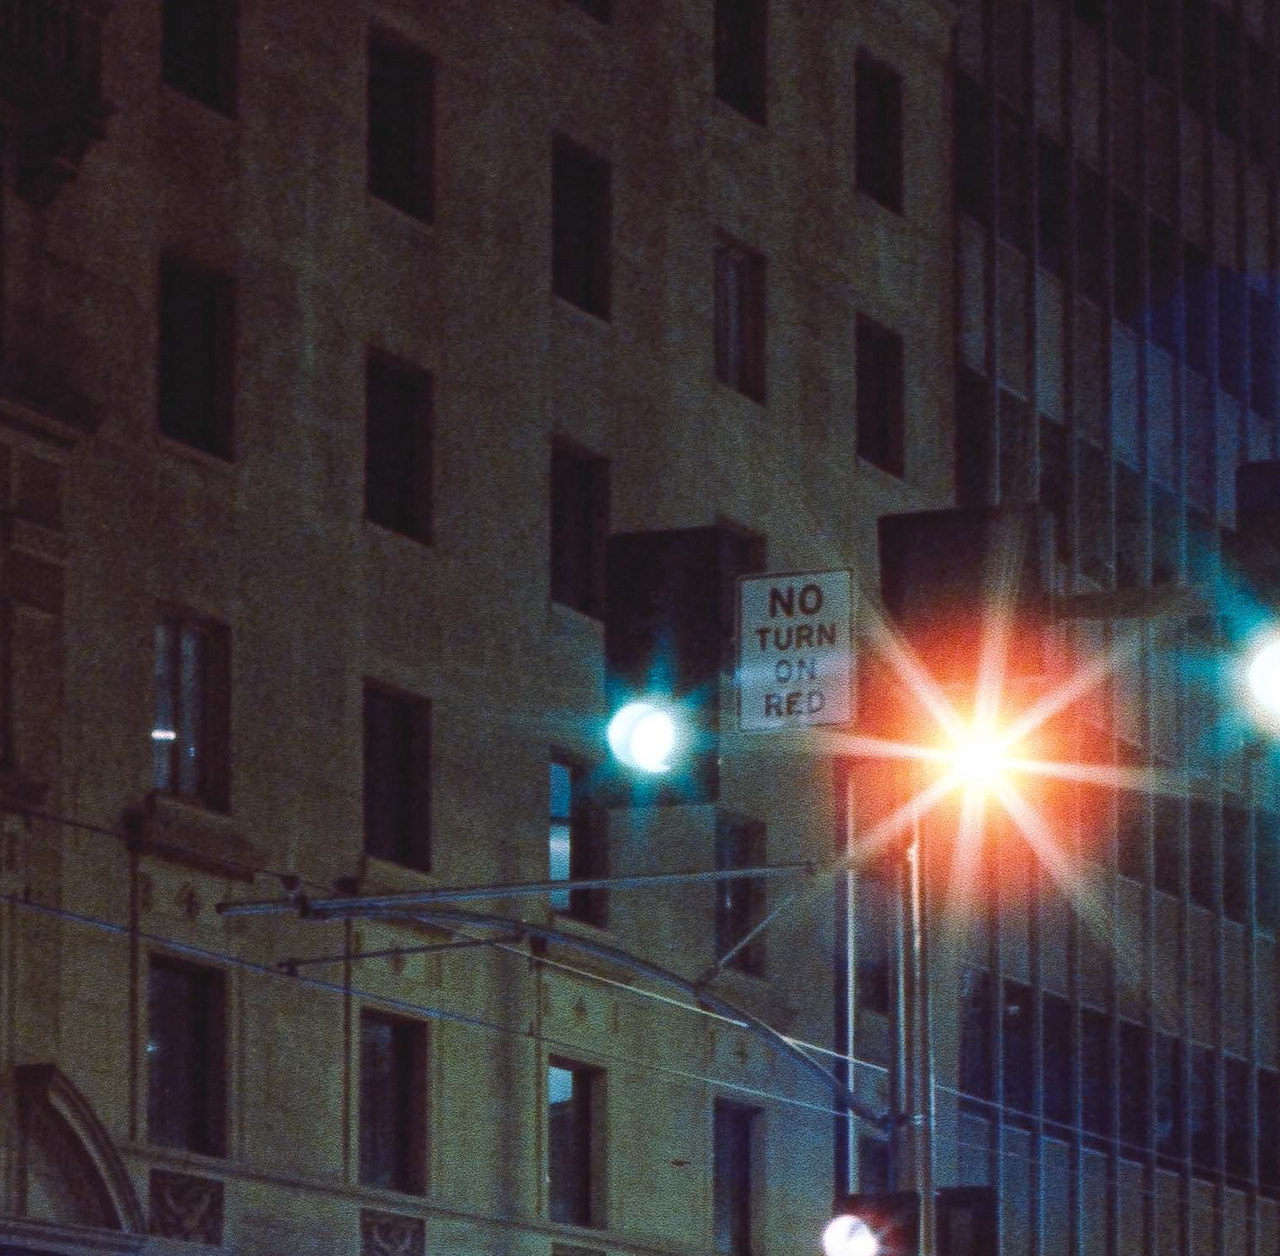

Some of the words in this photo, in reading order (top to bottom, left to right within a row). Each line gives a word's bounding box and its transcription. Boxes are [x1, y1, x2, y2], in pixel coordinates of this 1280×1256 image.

[770, 583, 822, 618] NO
[756, 623, 836, 651] TURN
[775, 658, 817, 683] ON
[764, 690, 825, 718] RED
